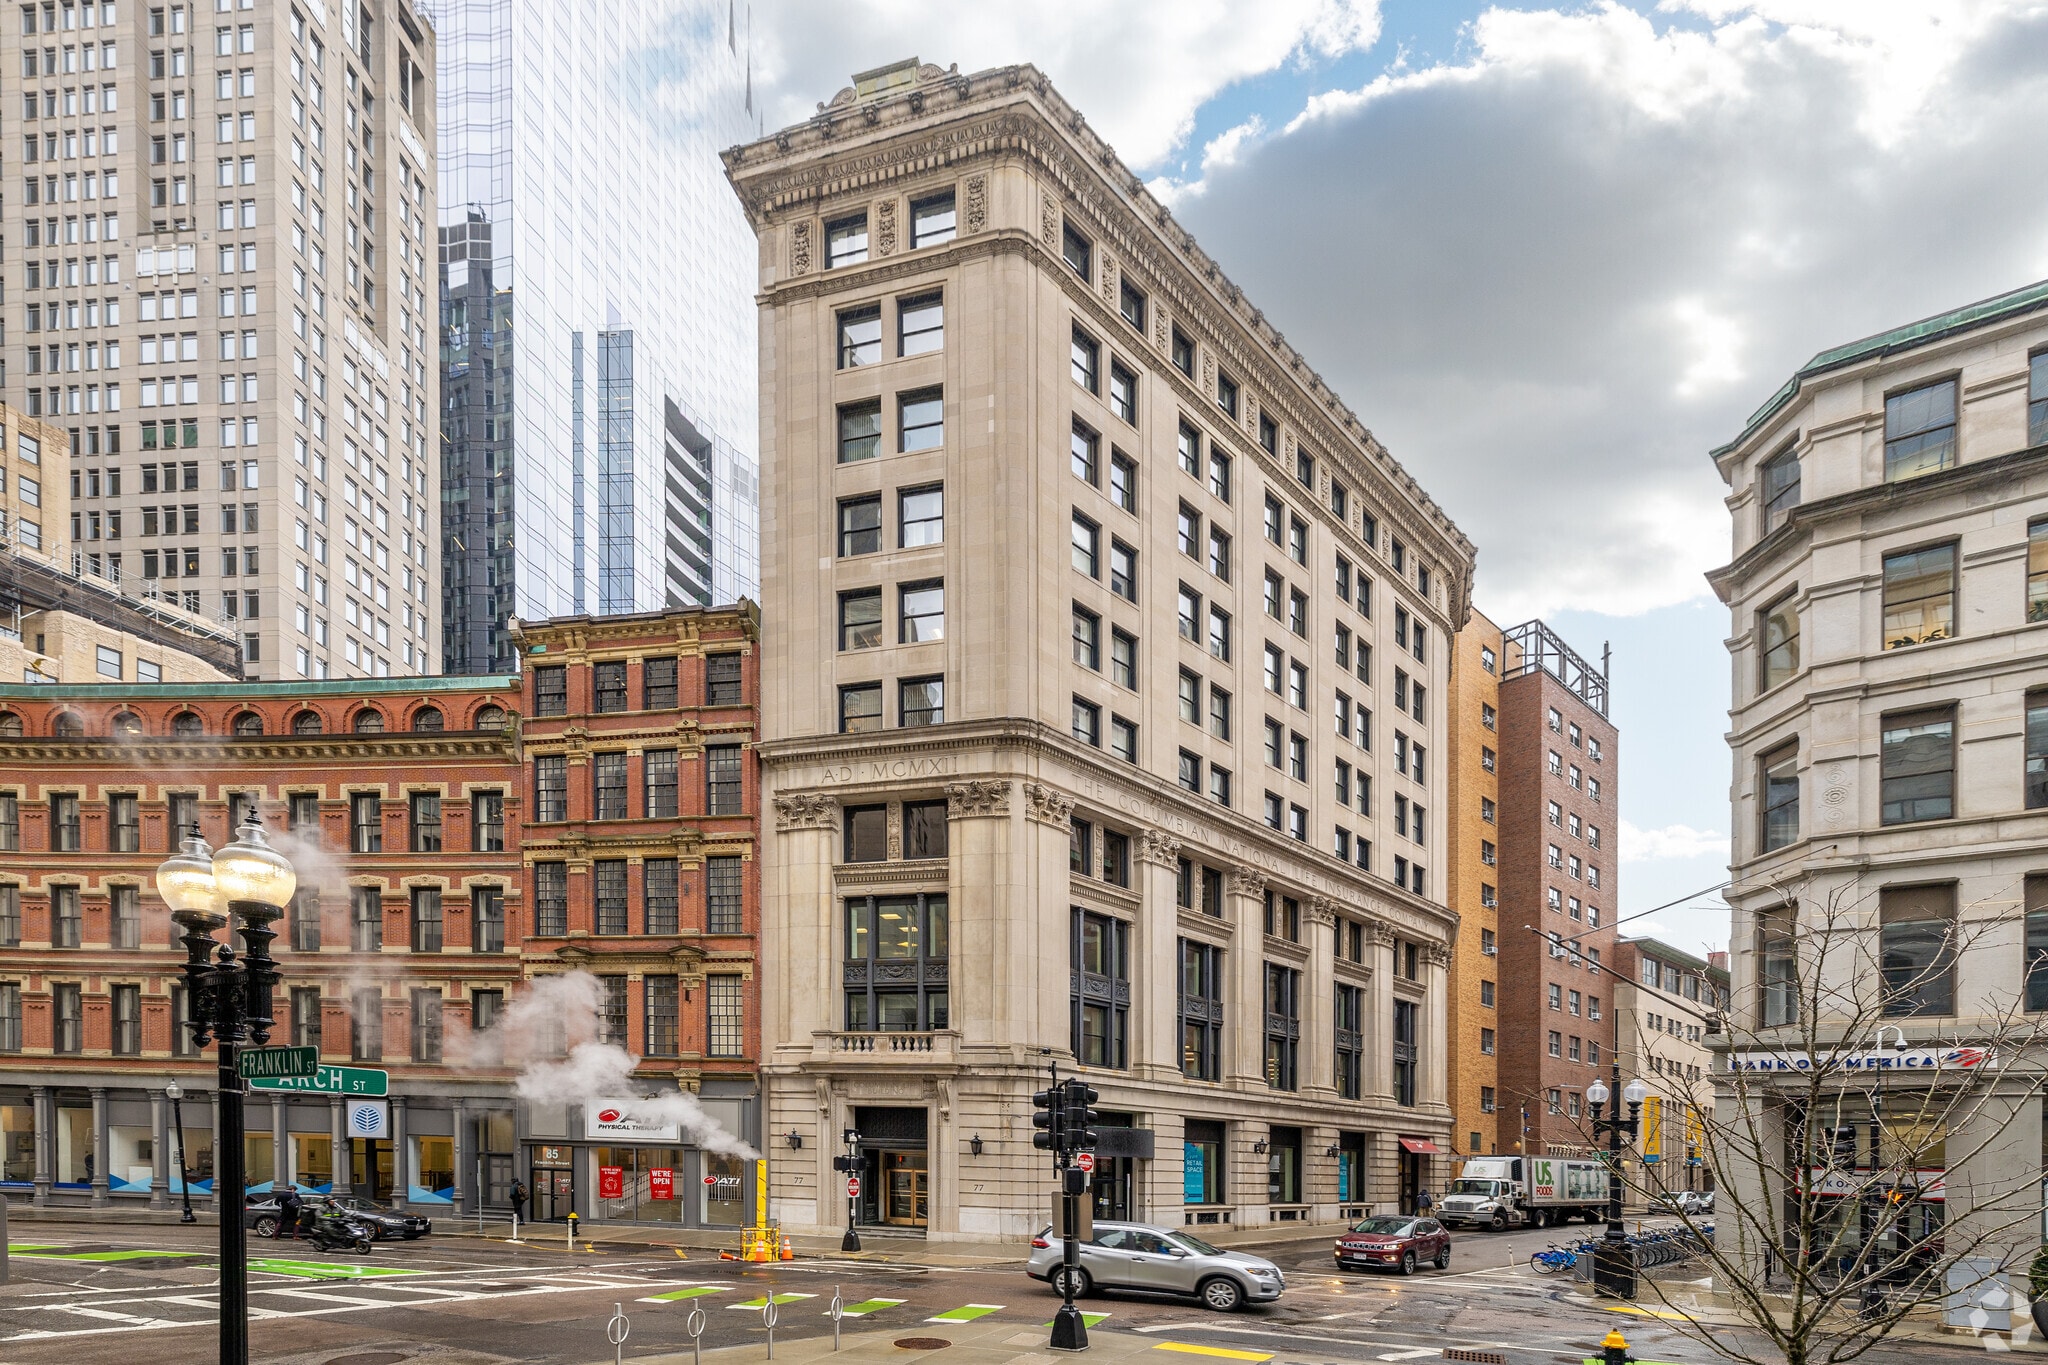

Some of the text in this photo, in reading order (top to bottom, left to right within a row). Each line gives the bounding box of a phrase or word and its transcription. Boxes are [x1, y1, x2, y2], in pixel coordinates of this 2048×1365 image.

[872, 756, 958, 780] MCMXII
[1071, 773, 1432, 932] THE COLUMBIAN NATIONAL LIFE INSURANCE COMPANY
[242, 1051, 315, 1075] FRANKLIN ST
[353, 1080, 366, 1091] ST
[597, 1123, 631, 1131] PHYSICAL
[546, 1149, 559, 1159] 85
[1186, 1159, 1203, 1167] RETAIL
[651, 1170, 672, 1178] WE'RE
[973, 1184, 984, 1192] 77
[1535, 1186, 1553, 1196] FOODS
